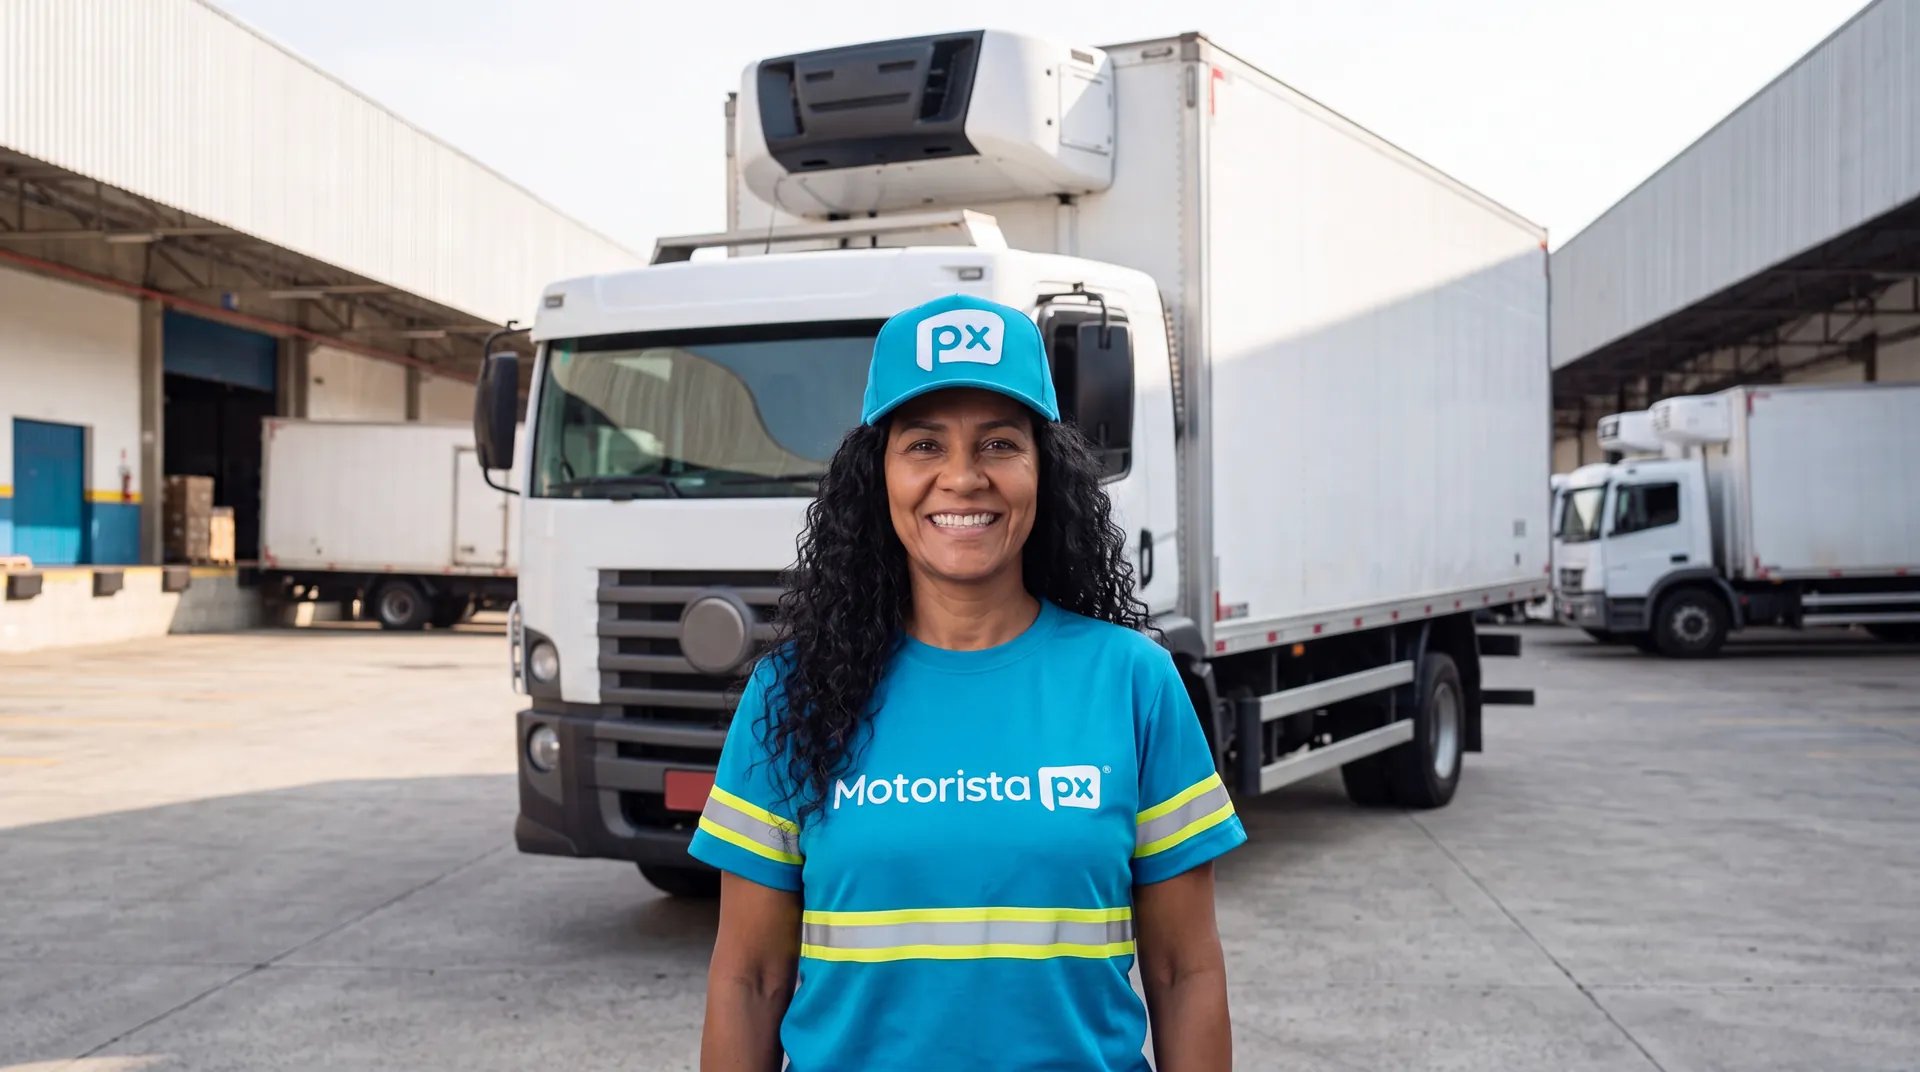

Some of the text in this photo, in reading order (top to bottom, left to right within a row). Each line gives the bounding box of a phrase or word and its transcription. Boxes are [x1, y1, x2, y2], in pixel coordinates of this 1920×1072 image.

[928, 320, 995, 371] px
[834, 769, 1096, 811] Motorista px
